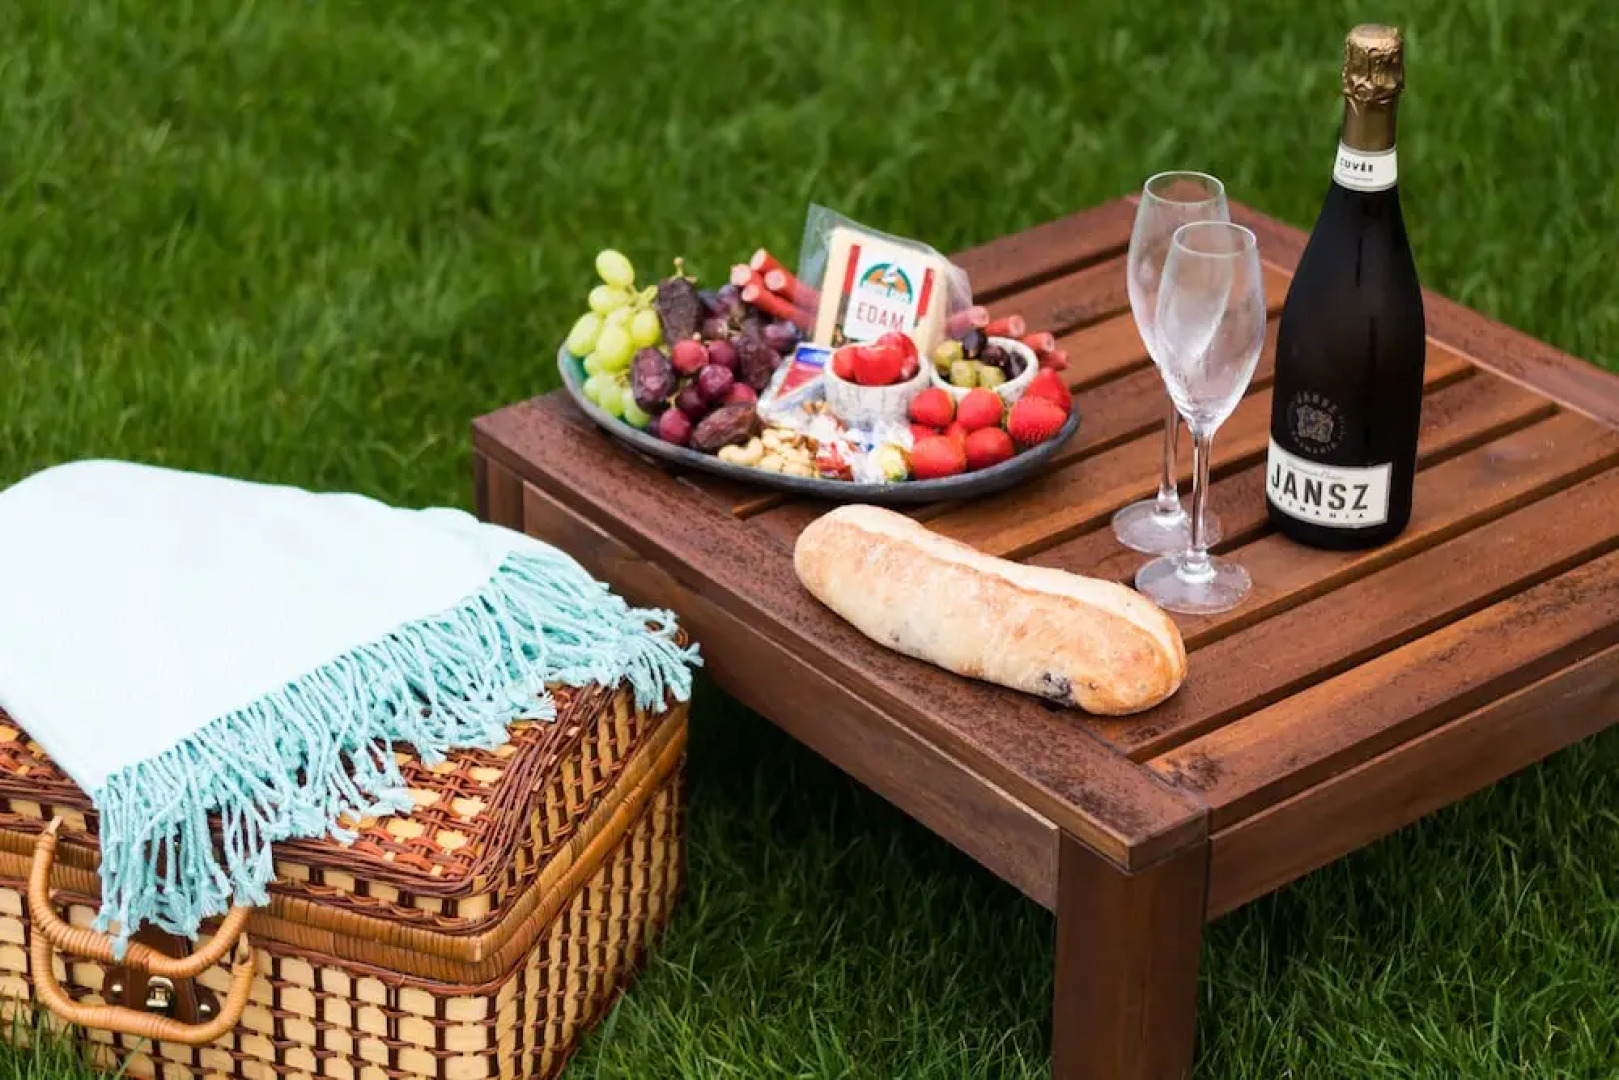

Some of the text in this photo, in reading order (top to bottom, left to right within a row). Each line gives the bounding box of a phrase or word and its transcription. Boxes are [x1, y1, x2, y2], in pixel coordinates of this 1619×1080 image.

[856, 301, 904, 330] EDAM
[1272, 463, 1369, 511] JANSZ
[1272, 488, 1364, 519] MANIA
